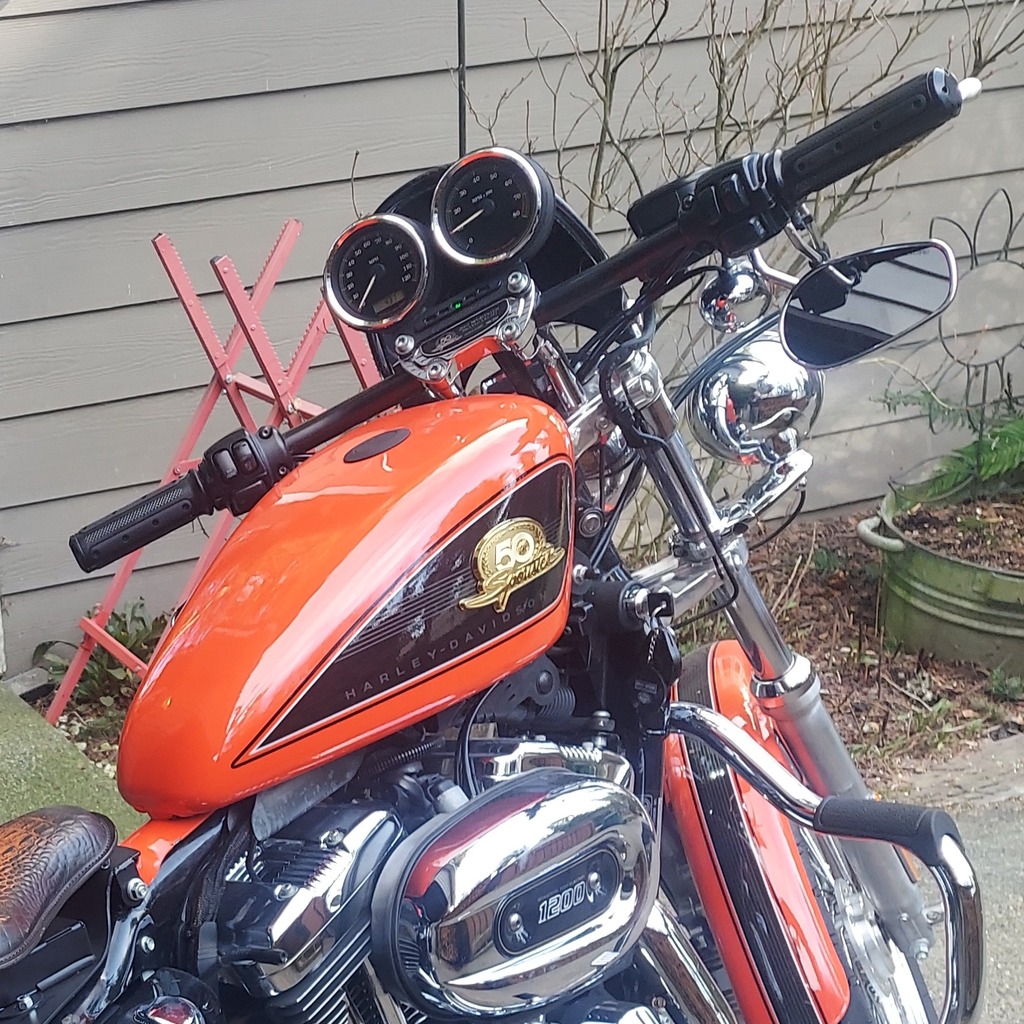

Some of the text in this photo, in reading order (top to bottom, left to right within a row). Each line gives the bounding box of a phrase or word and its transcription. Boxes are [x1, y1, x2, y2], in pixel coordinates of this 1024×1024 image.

[472, 175, 480, 184] 40
[504, 178, 513, 187] 60
[459, 189, 467, 197] 30
[347, 259, 355, 267] 40
[495, 531, 535, 571] 50
[538, 881, 586, 924] 1200
